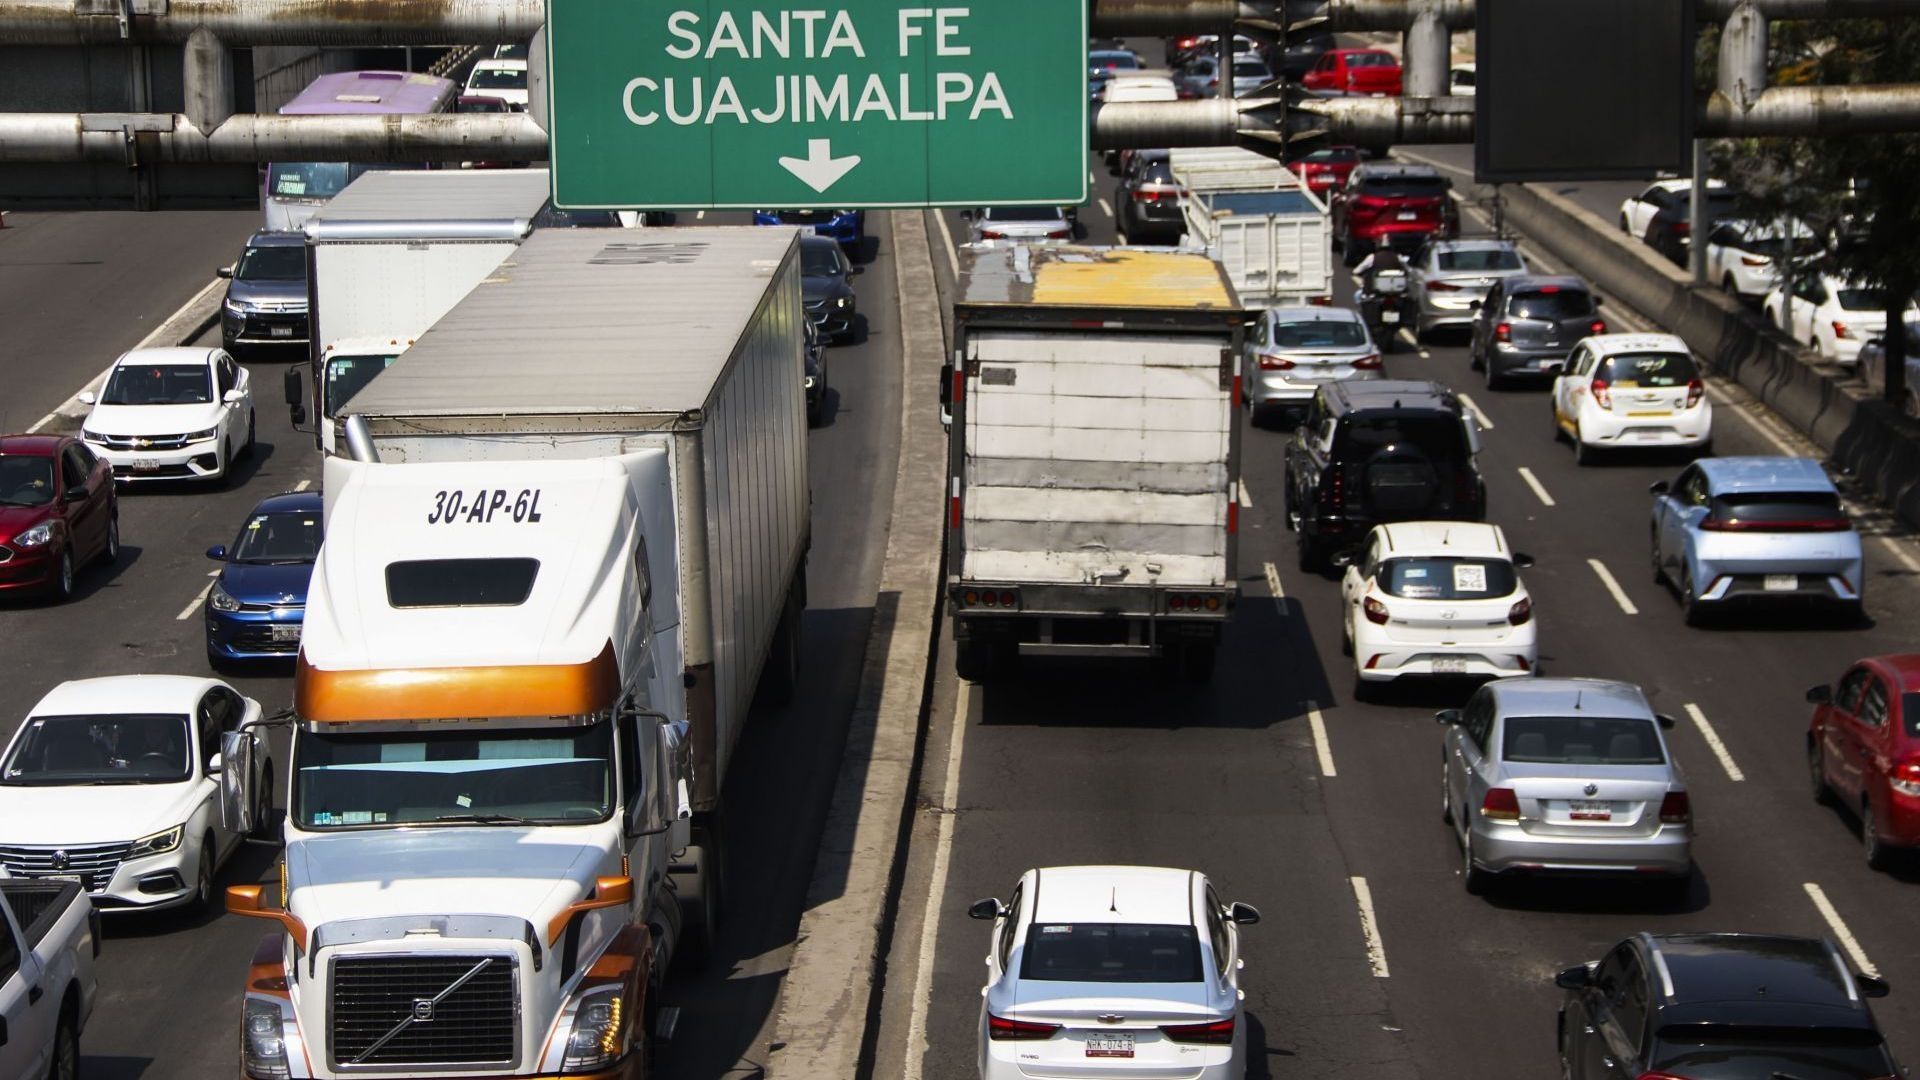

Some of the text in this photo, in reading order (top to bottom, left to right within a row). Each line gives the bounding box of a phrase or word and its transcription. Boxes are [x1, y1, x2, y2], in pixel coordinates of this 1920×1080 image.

[665, 8, 970, 59] SANTA FE
[623, 72, 1013, 125] CUAJIMALPA
[429, 489, 541, 524] 30-AP-6L
